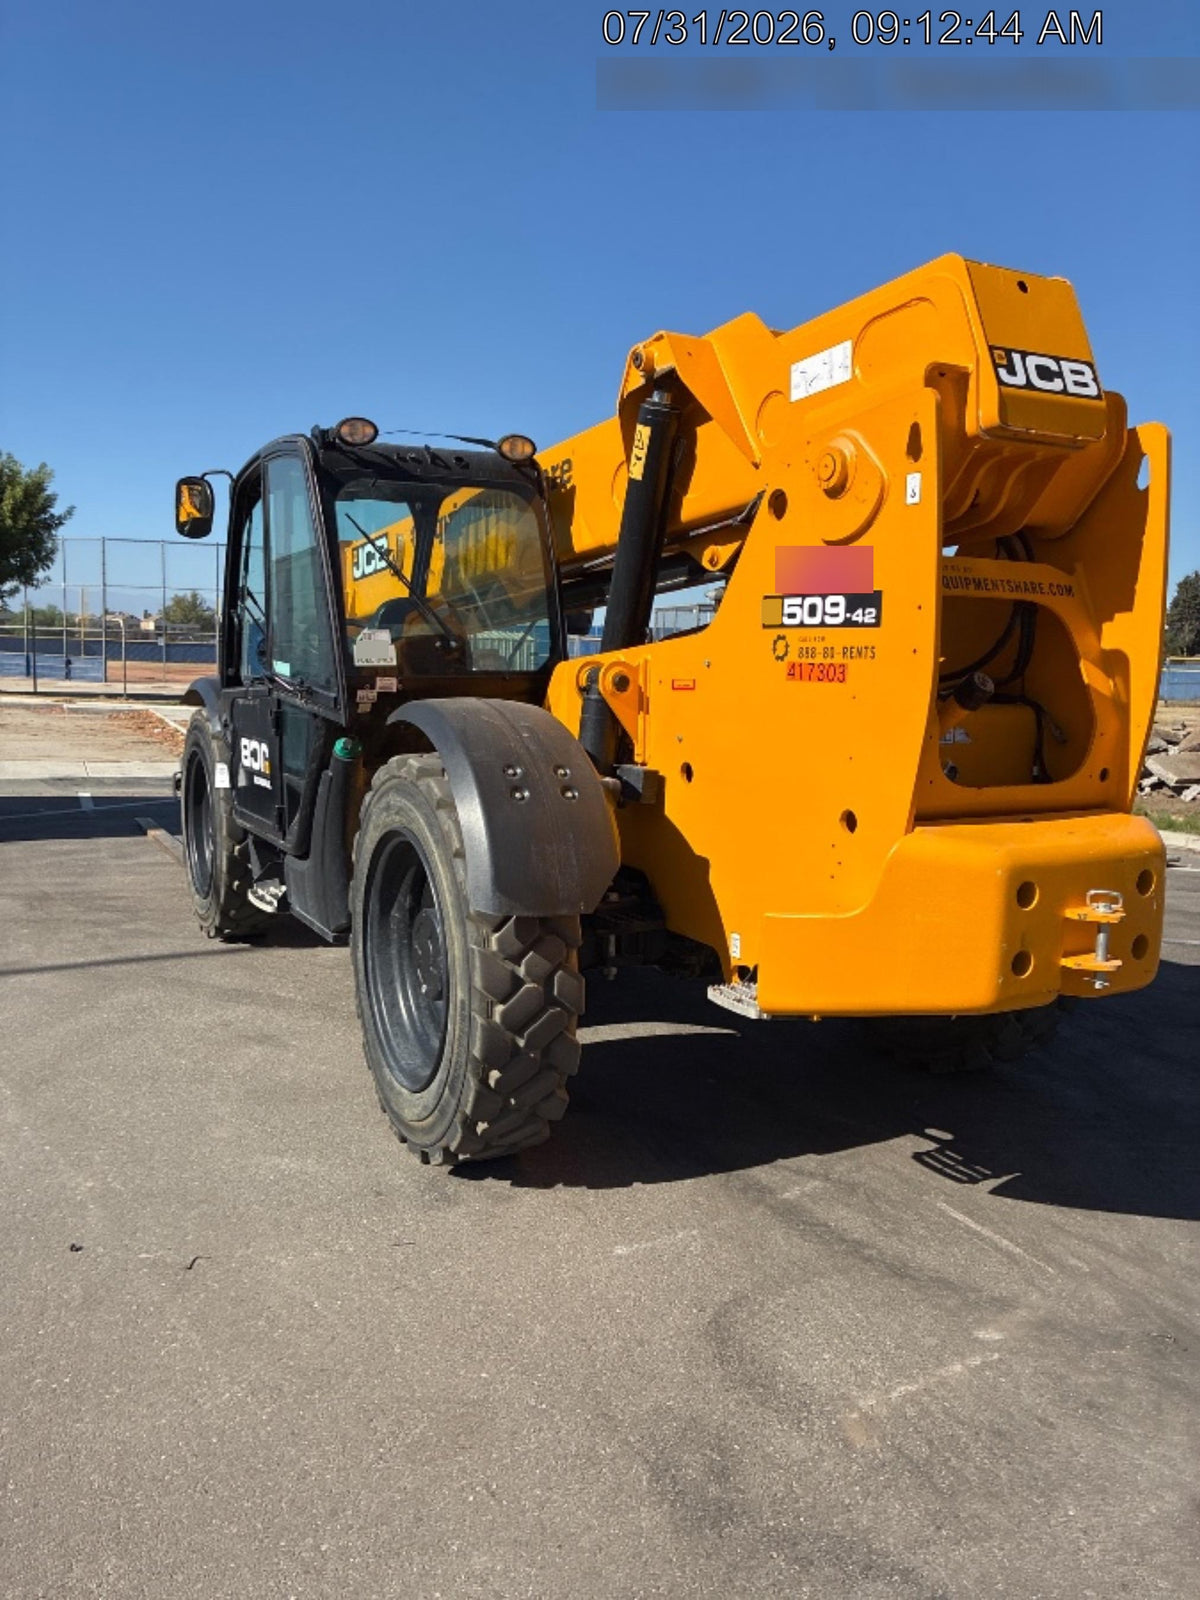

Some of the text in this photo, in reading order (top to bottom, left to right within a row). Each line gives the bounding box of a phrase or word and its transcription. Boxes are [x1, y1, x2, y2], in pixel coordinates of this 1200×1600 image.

[997, 352, 1099, 397] JCB
[942, 575, 1075, 598] QUIPMENTSHARE.COM
[787, 662, 846, 683] 417303
